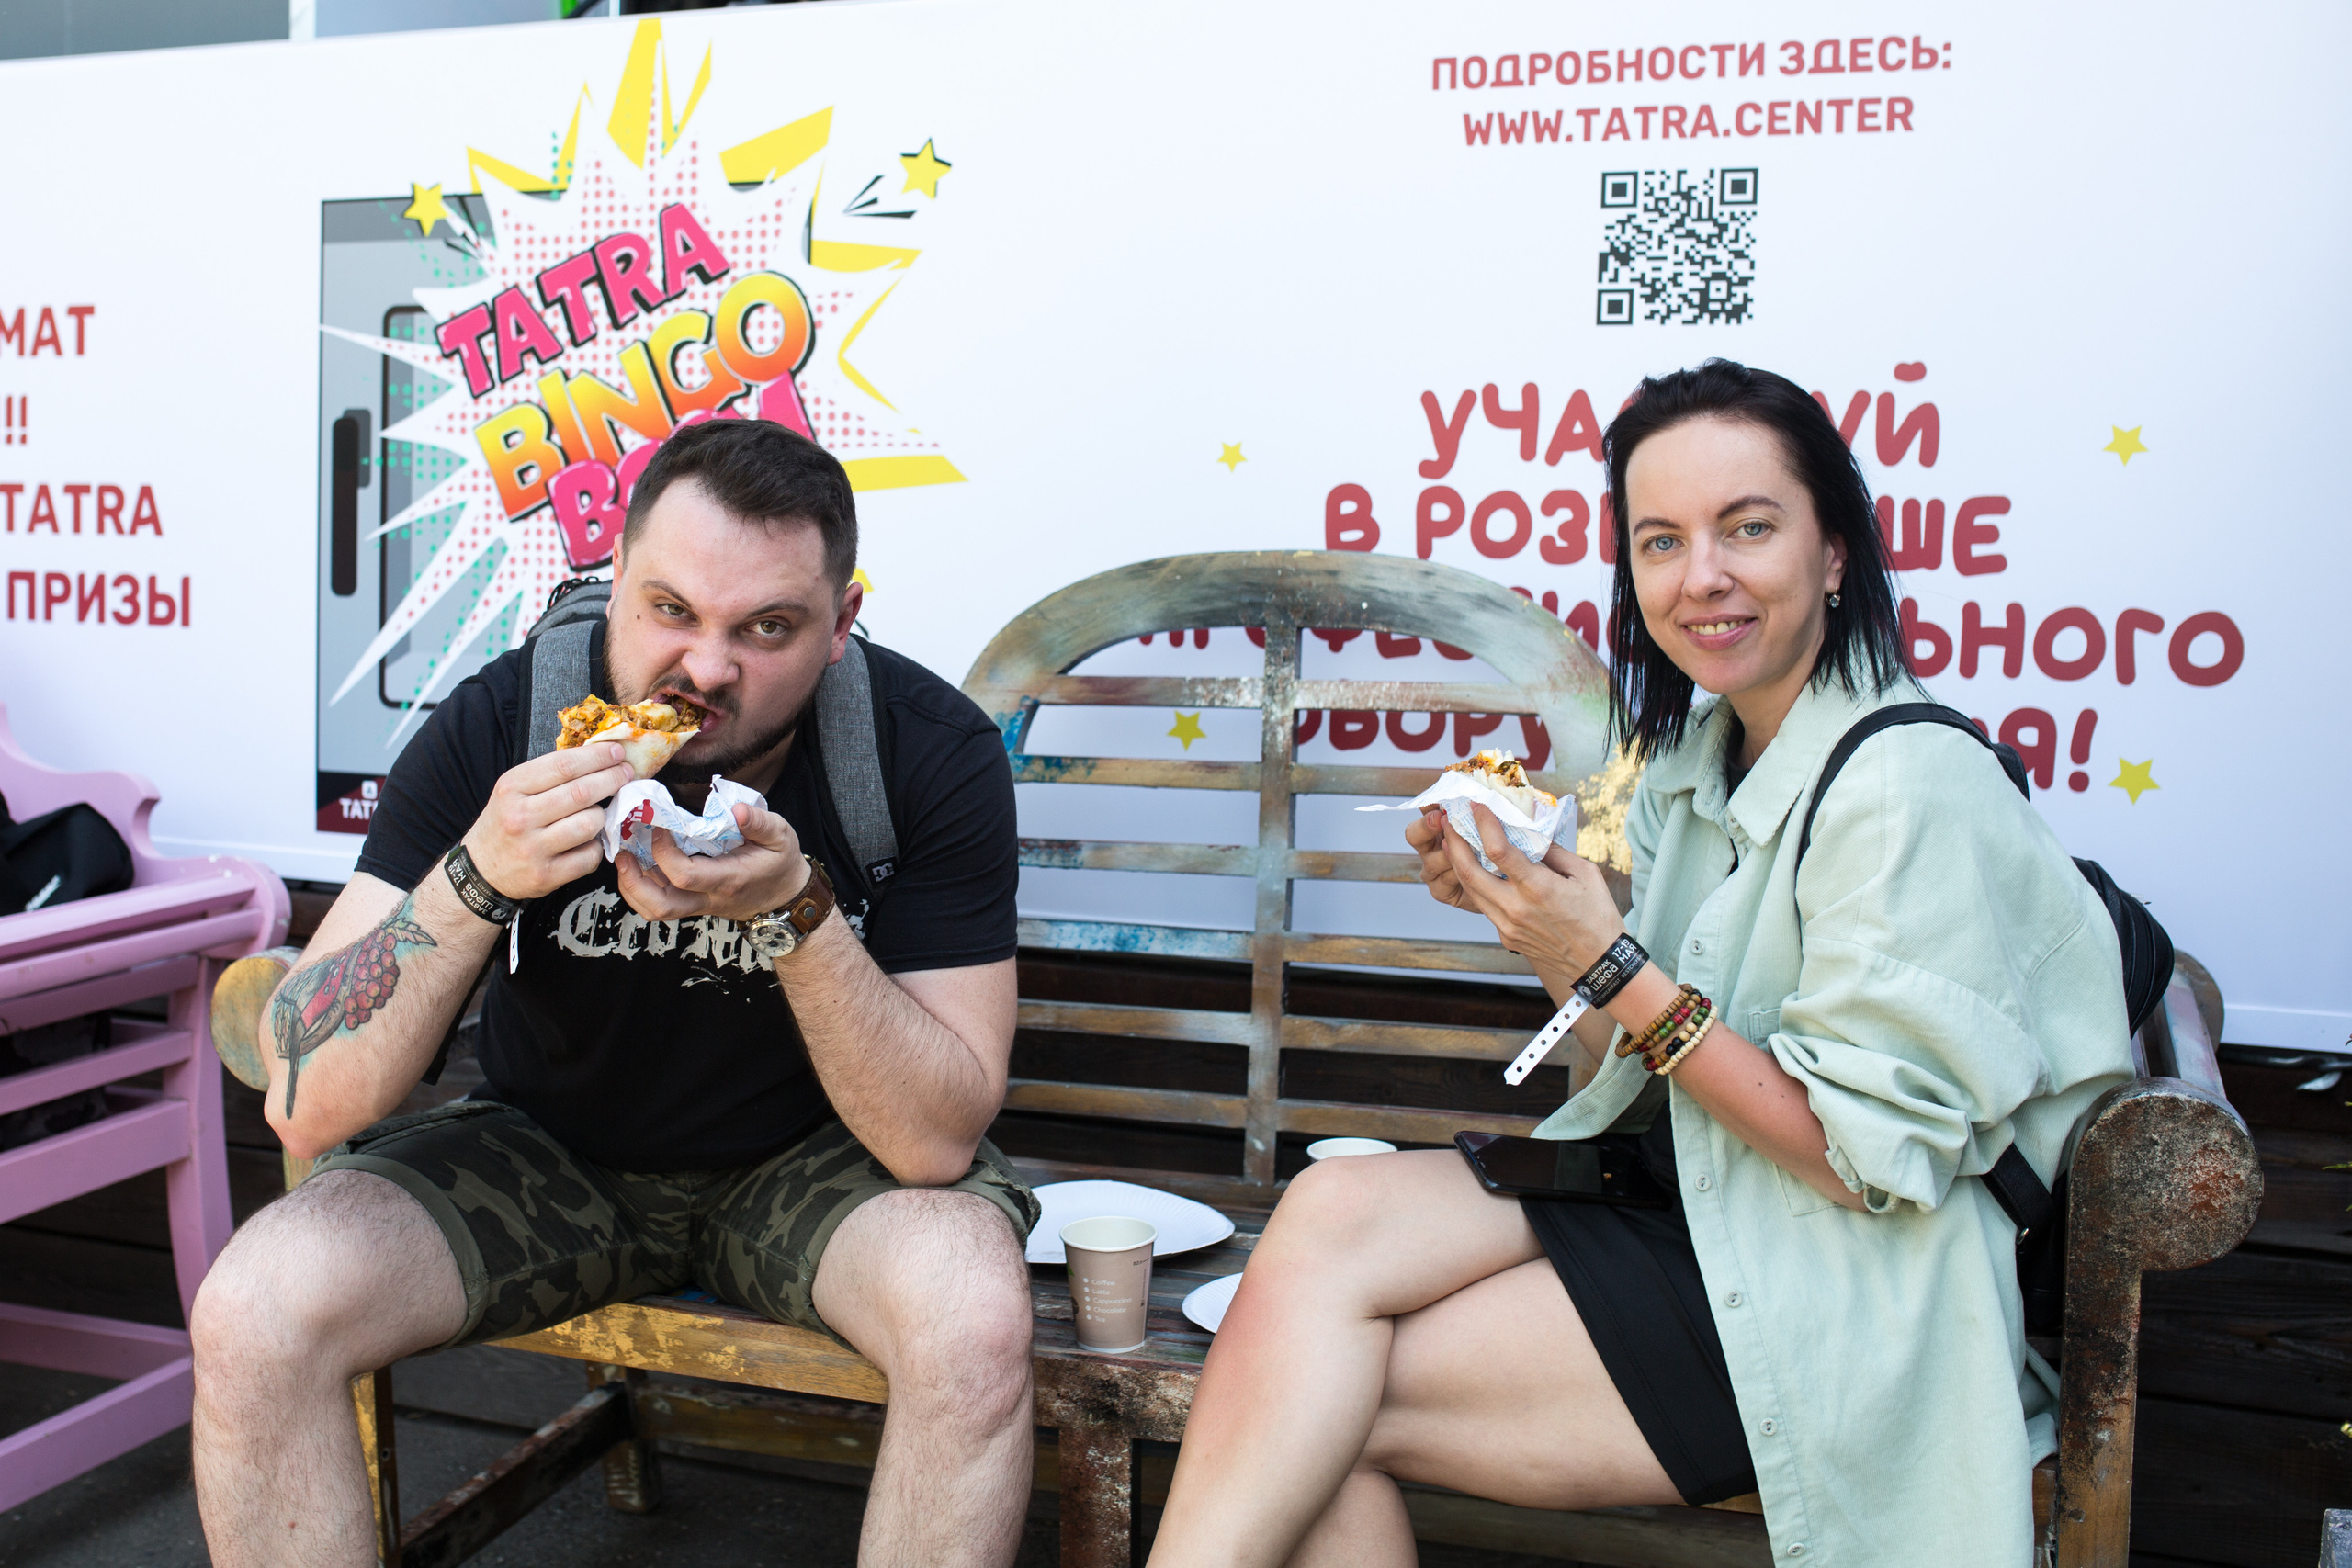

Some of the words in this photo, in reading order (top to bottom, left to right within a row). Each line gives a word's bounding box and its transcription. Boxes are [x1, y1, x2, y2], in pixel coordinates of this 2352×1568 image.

[1431, 42, 1766, 91] ПОДРОБНОСТИ
[1779, 35, 1953, 76] ЗДЕСЬ:
[1463, 96, 1915, 146] WWW.TATRA.CENTER
[435, 202, 730, 398] TATRA
[473, 271, 816, 523] BINGO
[0, 483, 163, 536] TATRA
[1325, 483, 1381, 553] В
[7, 570, 190, 628] ПРИЗЫ
[339, 797, 379, 820] TAT
[452, 858, 467, 881] МАЯ
[460, 887, 489, 915] ЗАВТРАК
[1611, 939, 1631, 958] 17-19
[1619, 943, 1637, 964] МАЯ
[1586, 959, 1612, 985] ЗАВТРАК
[1093, 1297, 1132, 1305] Cappuccino
